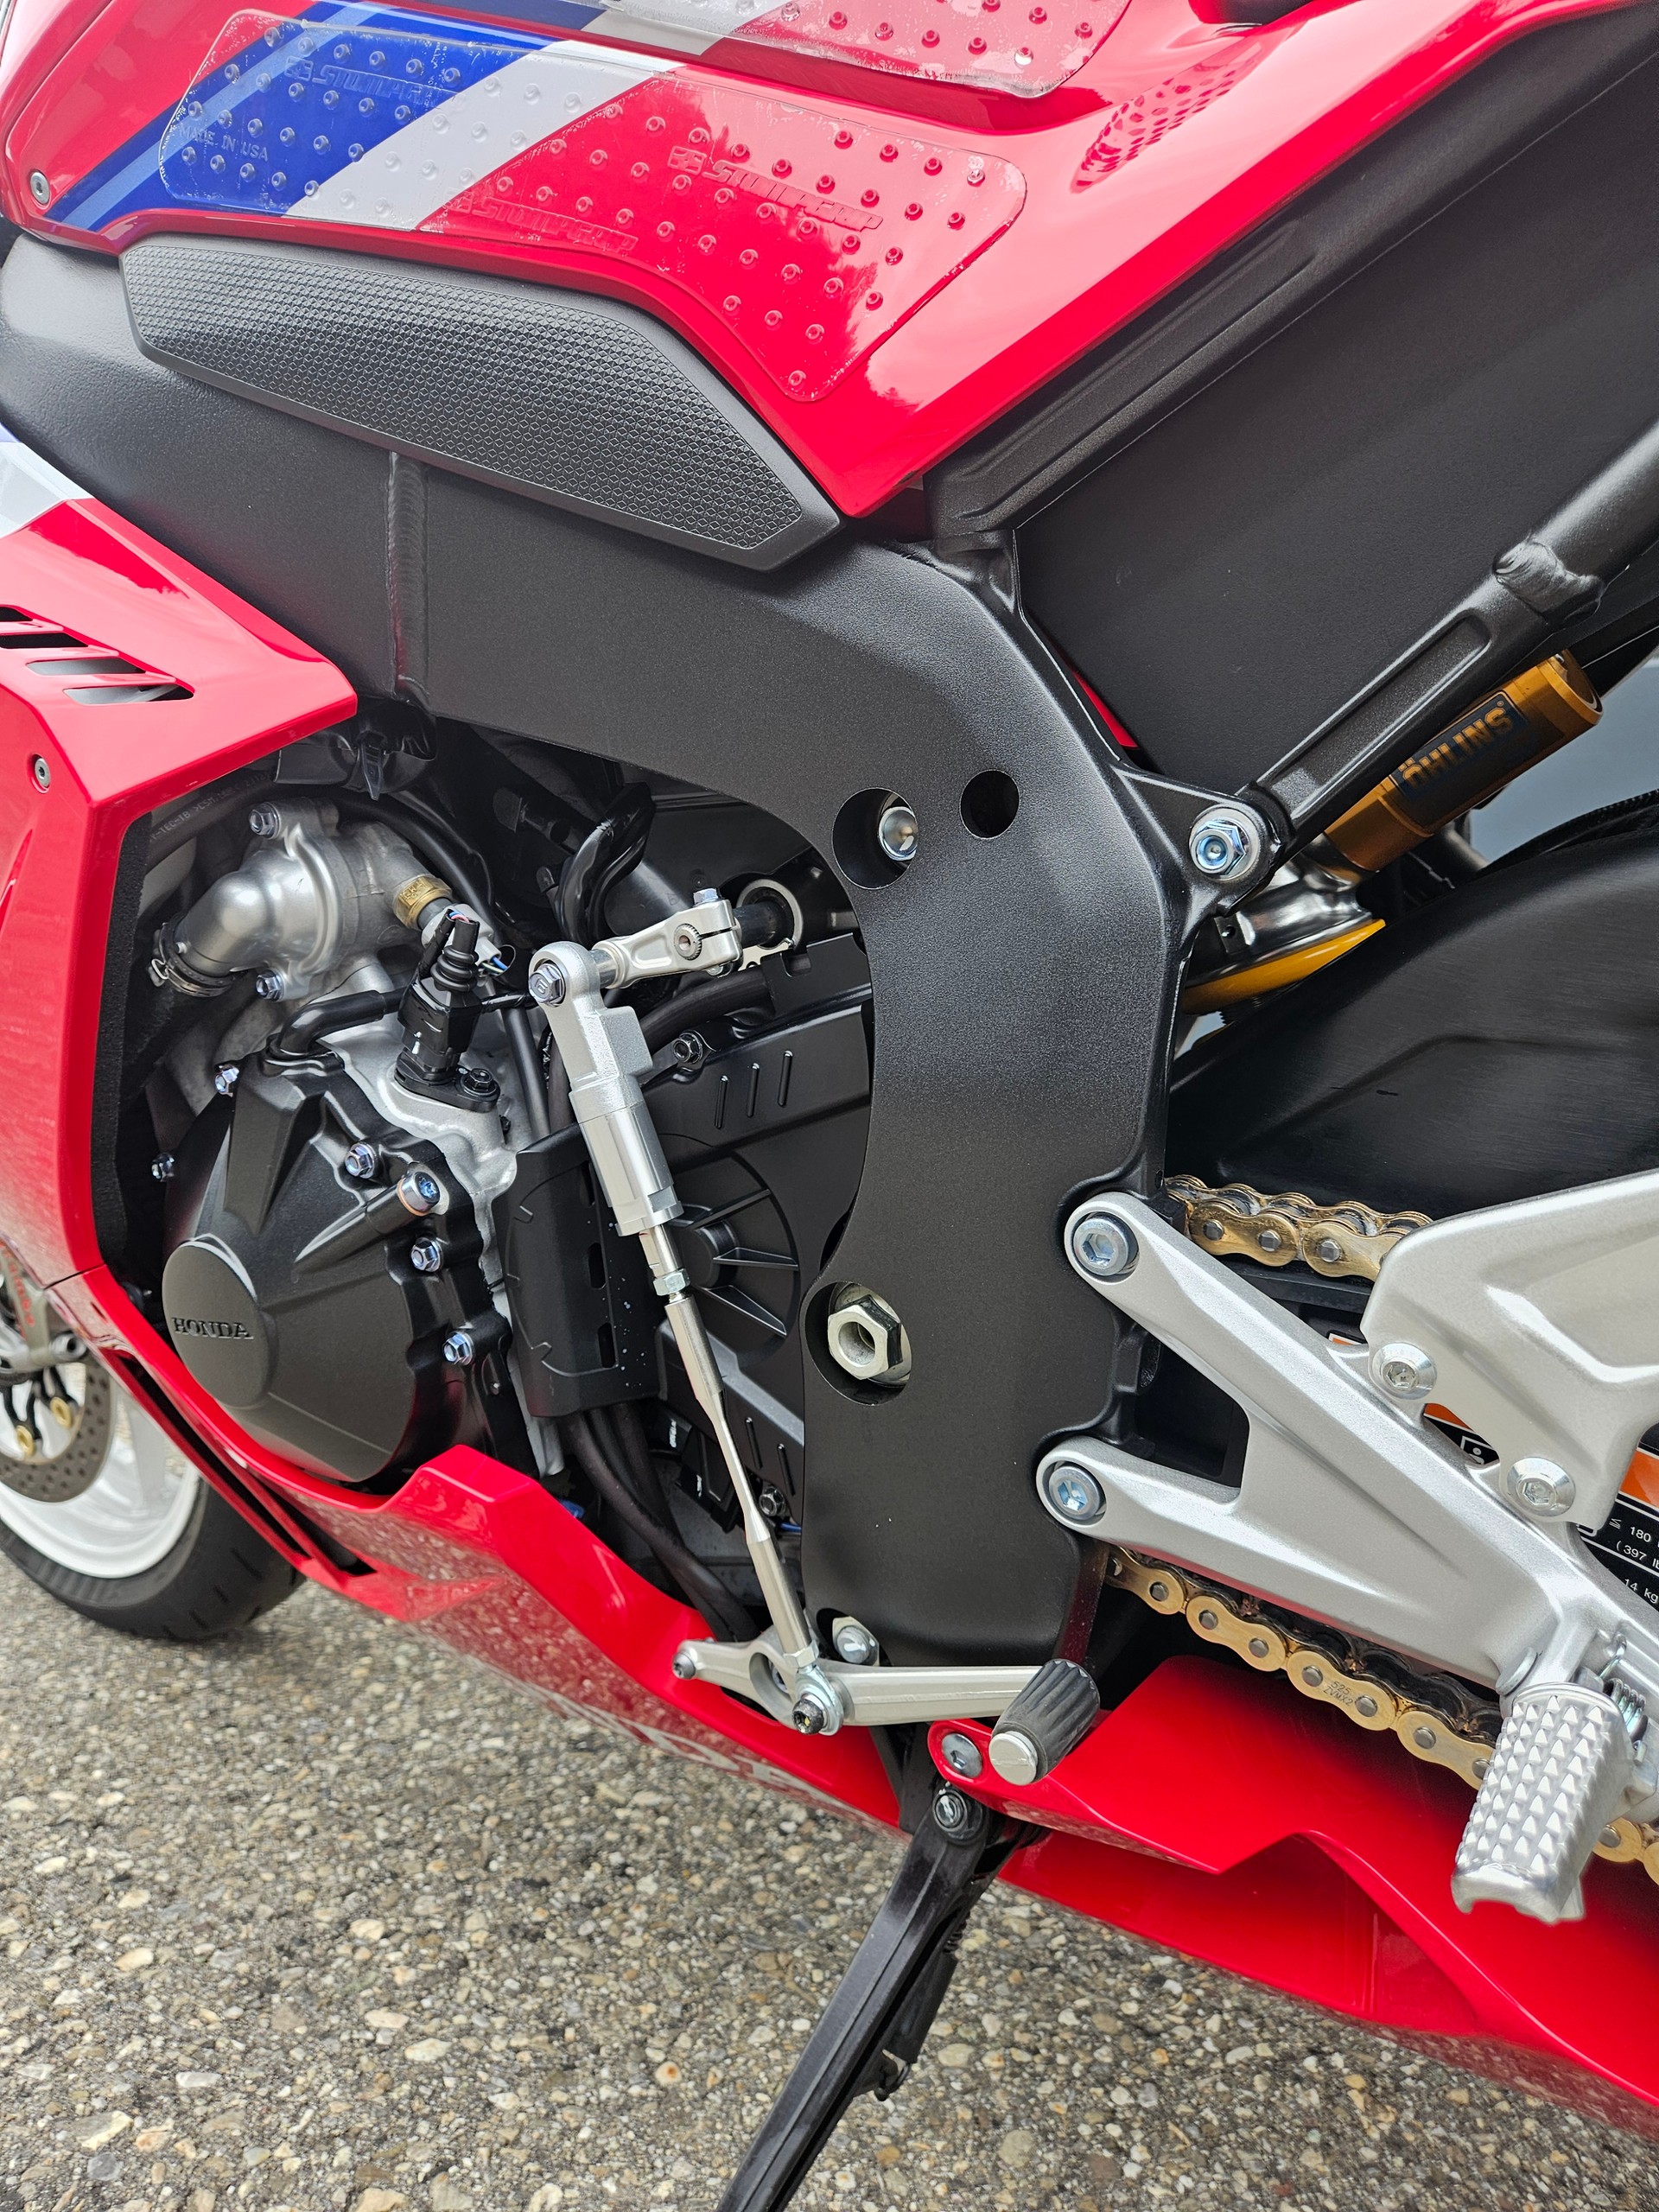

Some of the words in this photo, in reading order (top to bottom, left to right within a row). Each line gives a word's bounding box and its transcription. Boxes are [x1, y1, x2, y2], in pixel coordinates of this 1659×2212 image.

[180, 126, 216, 146] MADE
[221, 135, 236, 152] IN
[241, 141, 269, 162] USA
[1397, 707, 1513, 790] ÖHLINS
[172, 1318, 254, 1339] HONDA
[1630, 1526, 1651, 1542] 180
[1624, 1579, 1638, 1591] 14
[1643, 1588, 1659, 1604] kg
[1332, 1681, 1351, 1694] 525
